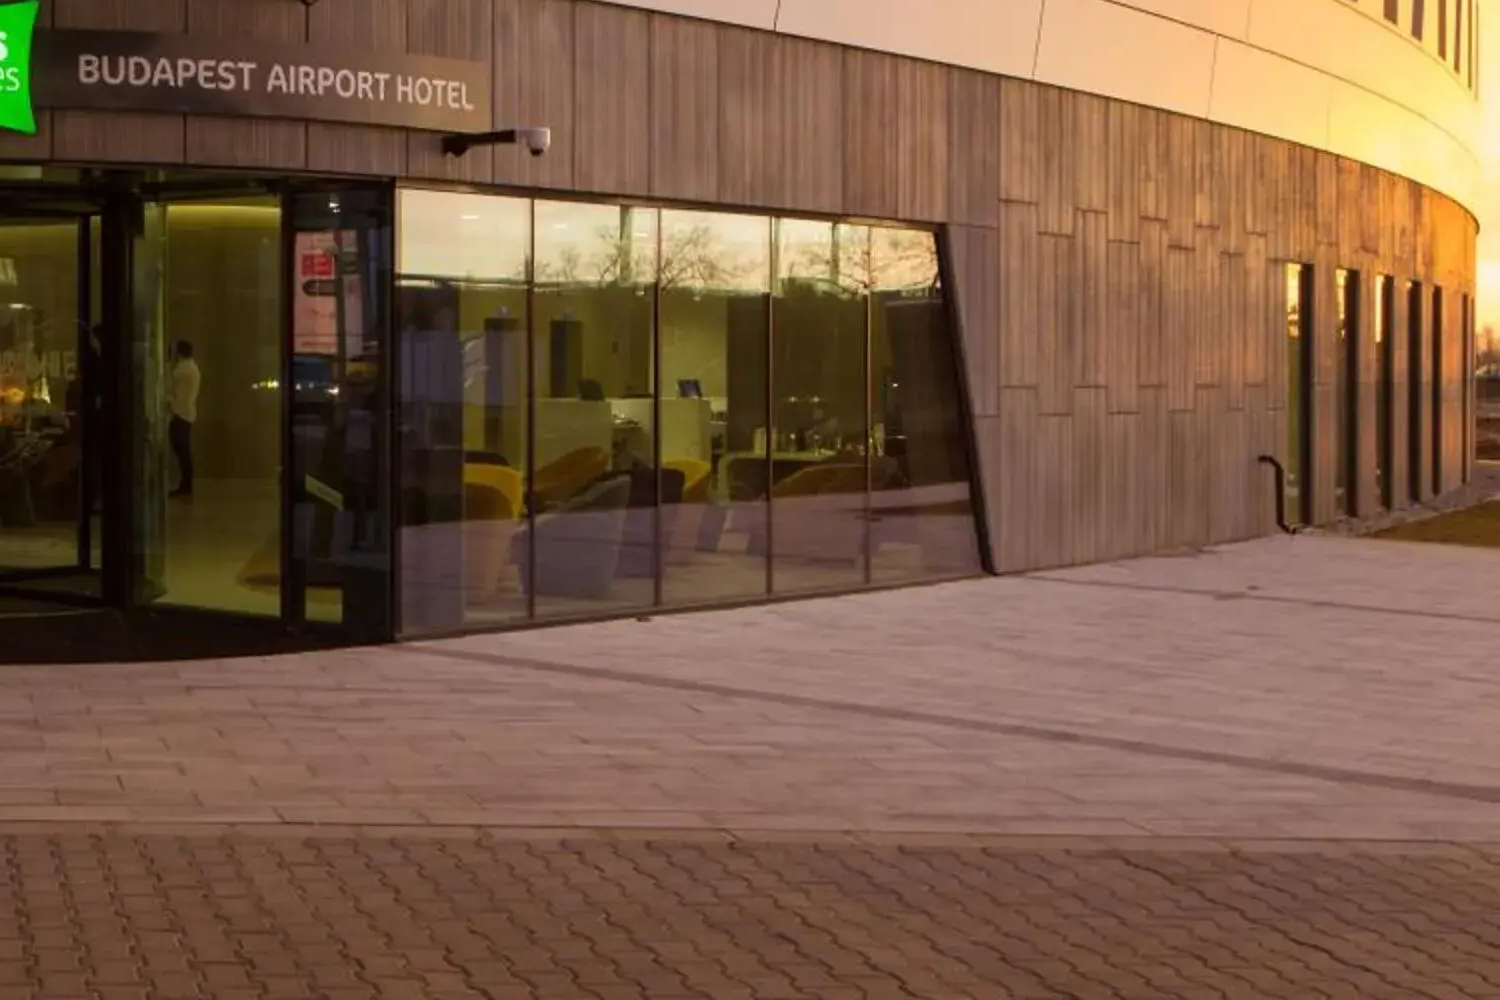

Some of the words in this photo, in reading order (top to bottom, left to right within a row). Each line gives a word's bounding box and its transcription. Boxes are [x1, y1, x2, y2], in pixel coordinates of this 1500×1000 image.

[77, 54, 257, 92] BUDAPEST
[266, 64, 391, 100] AIRPORT
[396, 75, 475, 111] HOTEL
